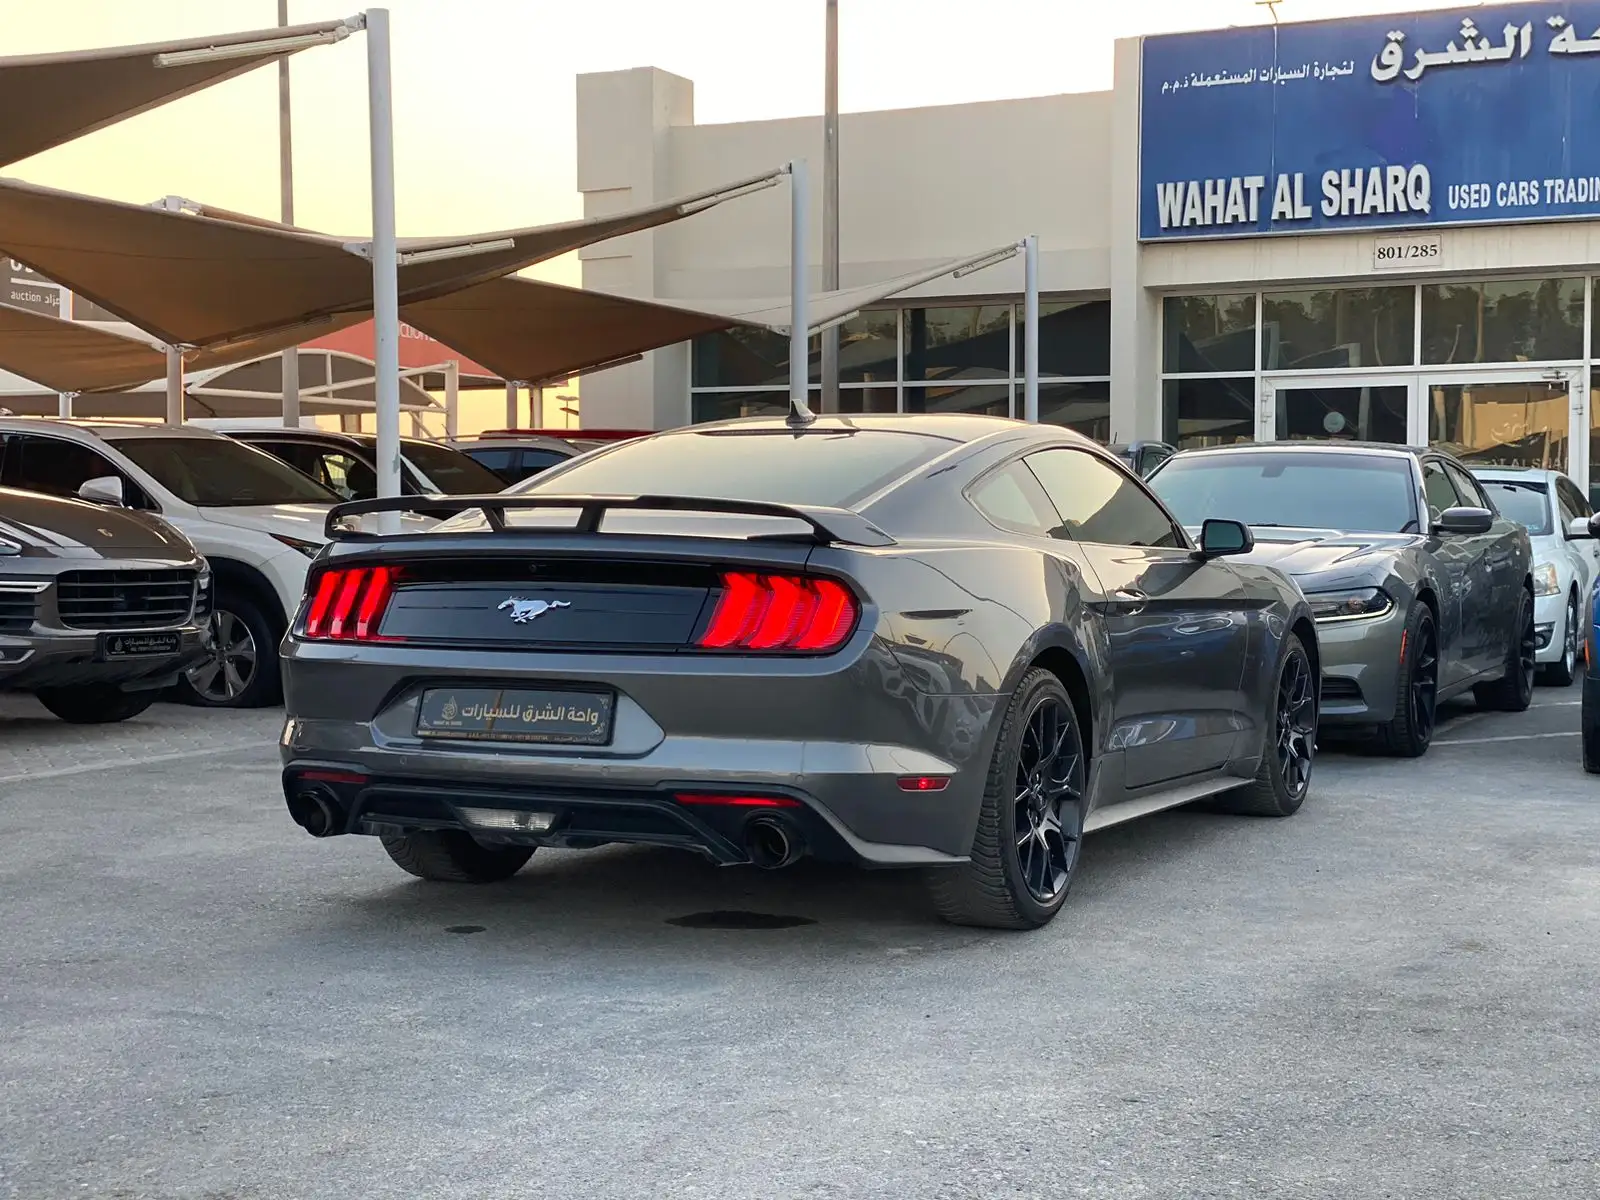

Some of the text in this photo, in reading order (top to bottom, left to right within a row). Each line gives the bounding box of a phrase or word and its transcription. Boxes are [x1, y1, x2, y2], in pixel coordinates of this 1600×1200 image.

[1371, 17, 1532, 81] الشرق
[1191, 68, 1257, 88] المستعملة
[1259, 64, 1310, 85] السيارات
[1313, 61, 1355, 81] لتجارة
[1156, 164, 1431, 228] WAHAT AL SHARQ
[1448, 183, 1491, 210] USED
[1496, 179, 1539, 207] CARS
[1377, 244, 1438, 260] 801/285
[10, 291, 41, 302] auction
[462, 702, 599, 725] واحة الشرق للسيارات
